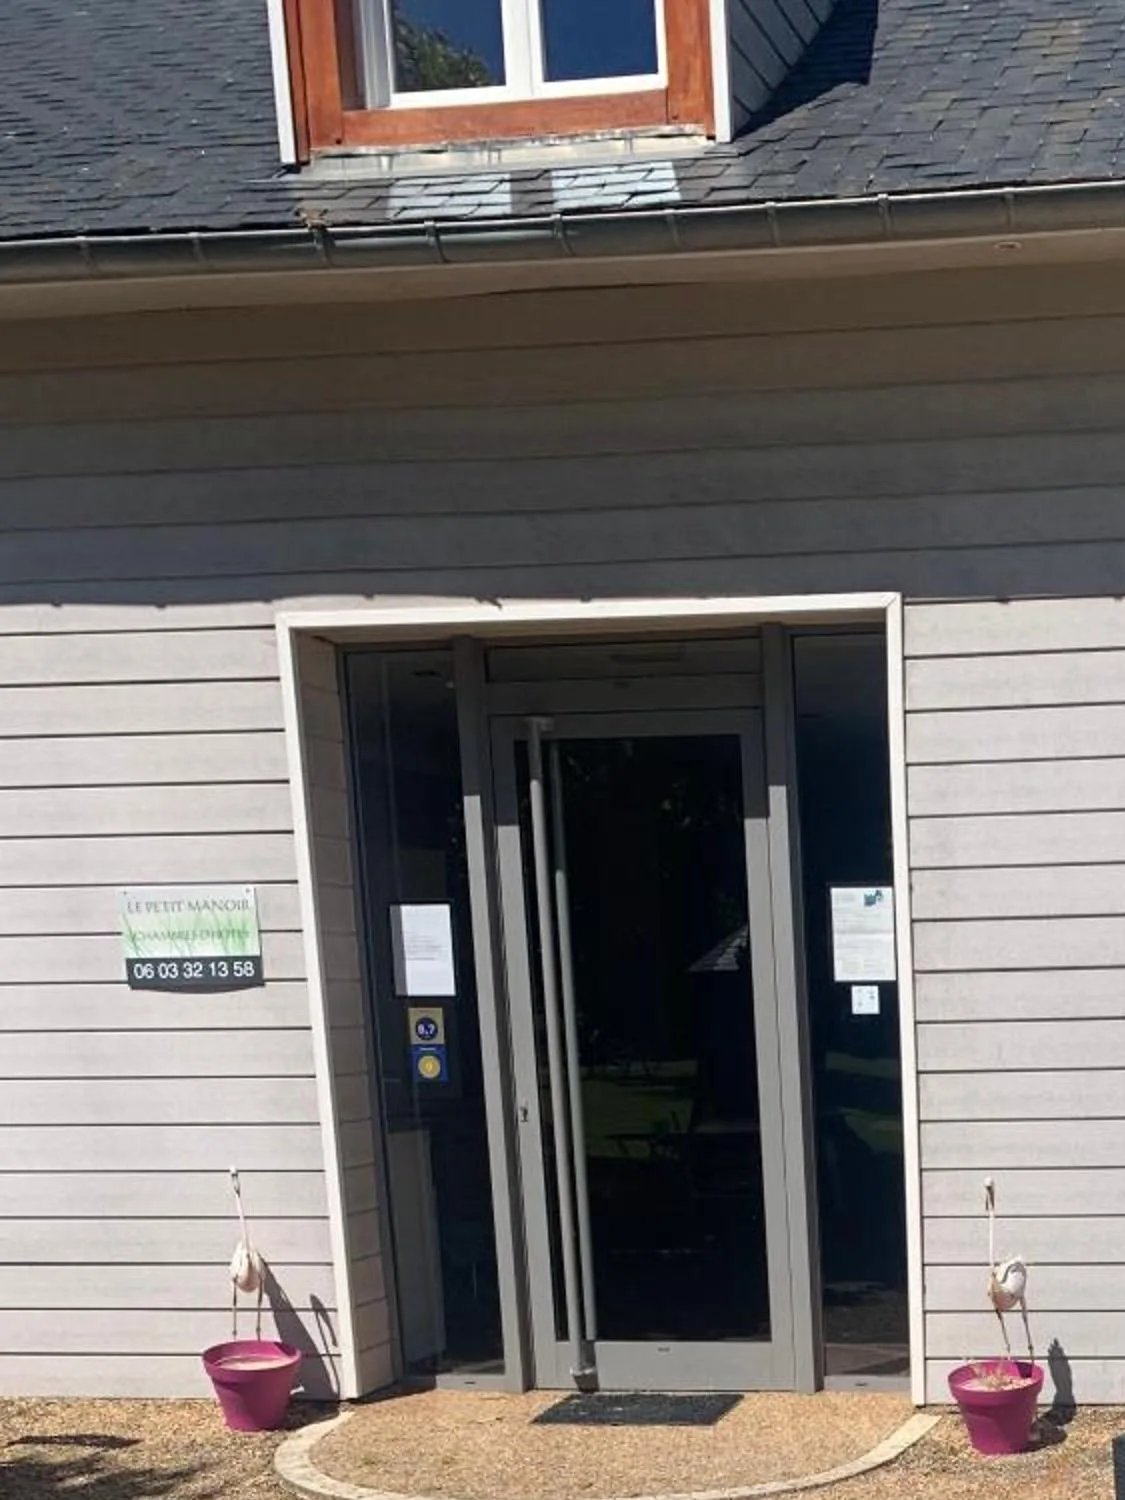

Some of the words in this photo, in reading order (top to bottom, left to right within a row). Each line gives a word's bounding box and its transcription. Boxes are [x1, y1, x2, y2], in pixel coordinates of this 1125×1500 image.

[127, 901, 141, 914] LE
[145, 899, 184, 913] PETIT
[187, 898, 250, 912] MANOIR
[133, 963, 155, 979] 06
[158, 963, 179, 979] 03
[183, 962, 204, 979] 32
[208, 961, 229, 978] 13
[233, 961, 255, 977] 58
